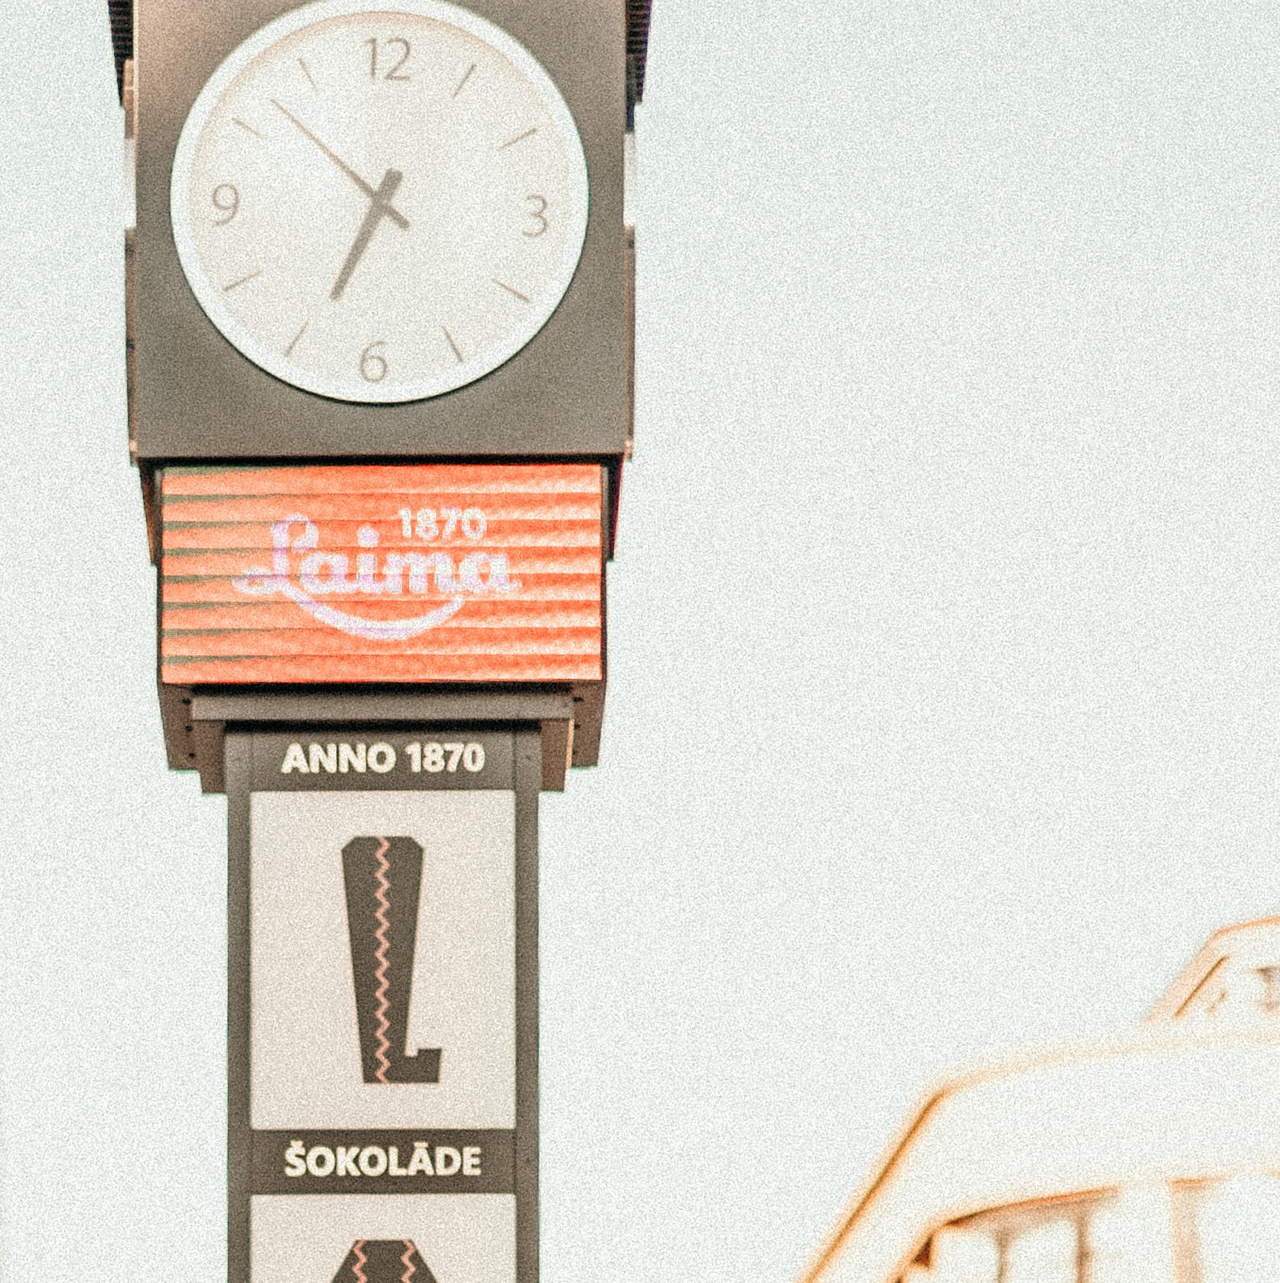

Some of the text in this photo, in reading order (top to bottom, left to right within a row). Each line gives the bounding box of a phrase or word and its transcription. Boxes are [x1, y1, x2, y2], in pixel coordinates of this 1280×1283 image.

[366, 36, 411, 81] 12
[211, 183, 241, 227] 9
[522, 193, 550, 239] 3
[358, 339, 390, 384] 6
[397, 507, 489, 541] 1870
[230, 513, 523, 595] Laima
[280, 741, 486, 774] ANNO 1870
[284, 1140, 482, 1177] ŠOKOLĀDE
